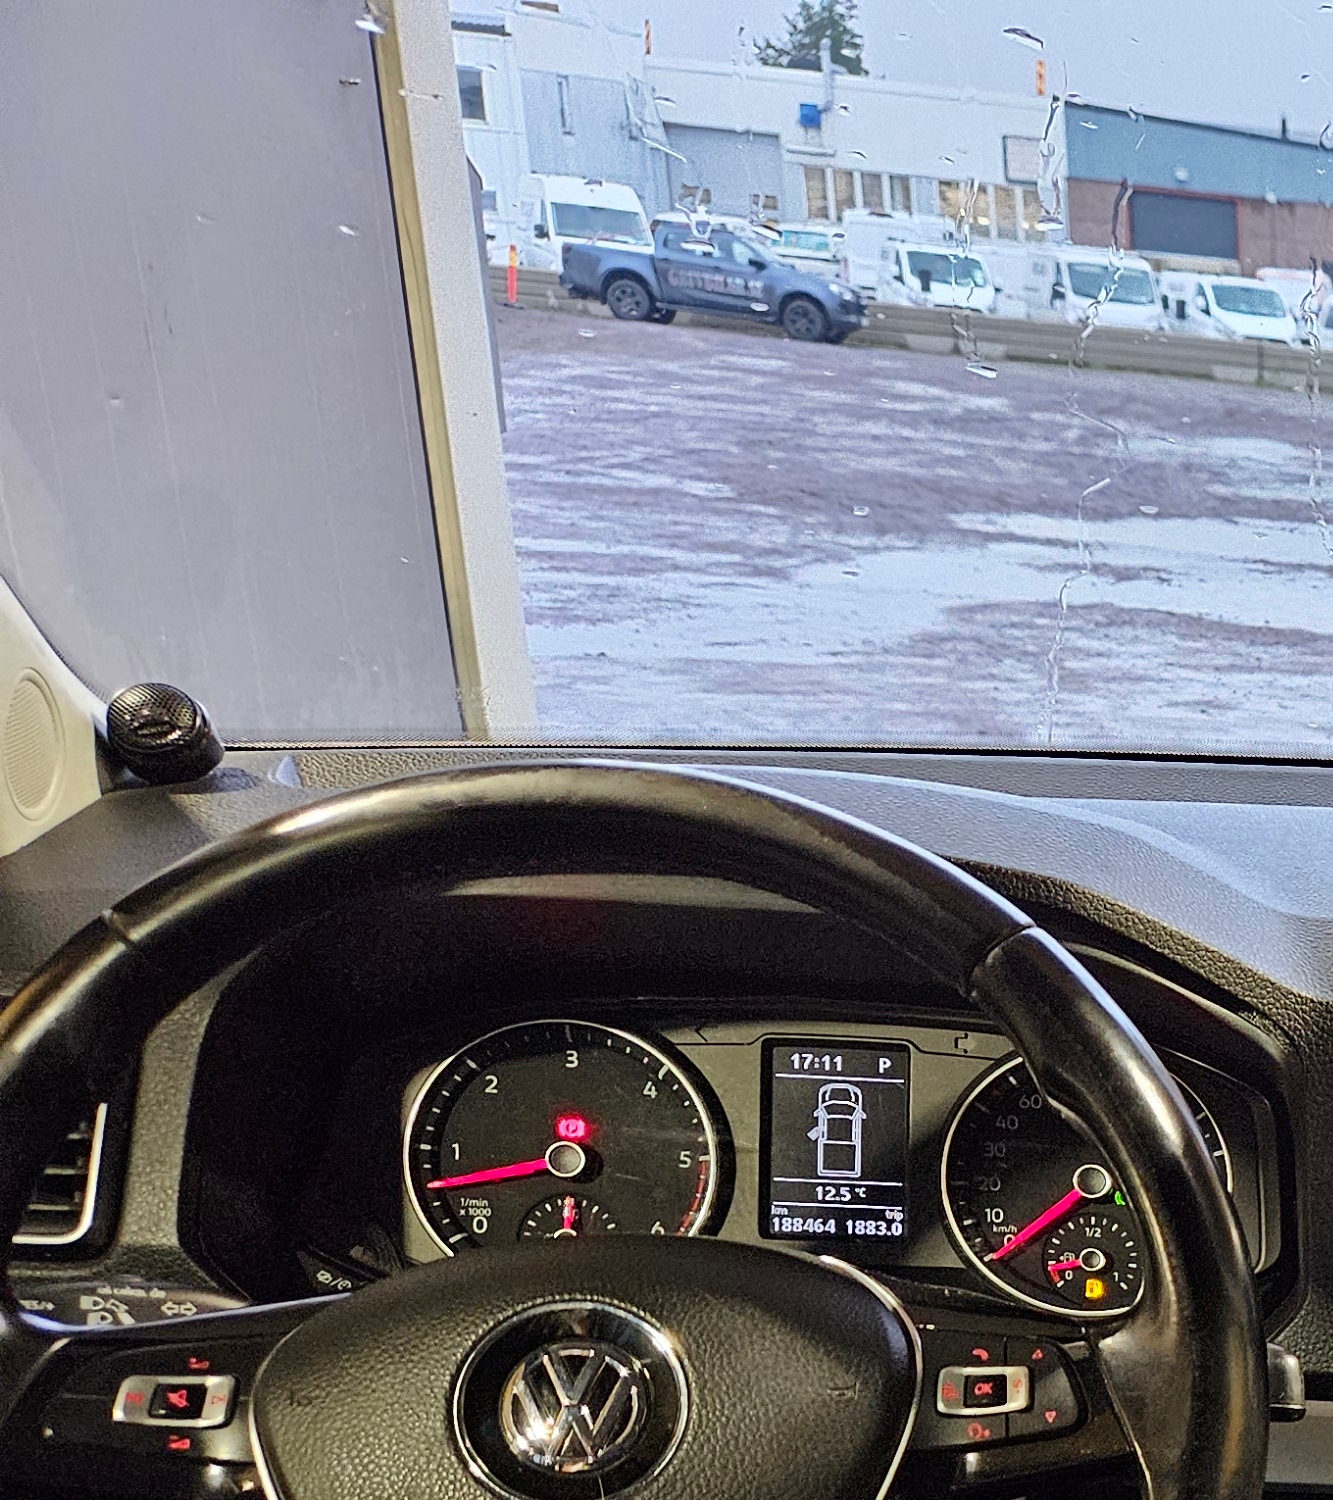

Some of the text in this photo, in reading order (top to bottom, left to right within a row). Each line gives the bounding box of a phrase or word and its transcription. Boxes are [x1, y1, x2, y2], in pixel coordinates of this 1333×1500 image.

[565, 1050, 579, 1069] 3
[790, 1053, 892, 1074] 17:11 P
[484, 1075, 499, 1094] 2
[642, 1081, 657, 1099] 4
[1018, 1093, 1042, 1109] 60
[995, 1115, 1019, 1130] 40
[451, 1143, 460, 1161] 1
[678, 1152, 692, 1169] 5
[815, 1185, 852, 1202] 12.5
[460, 1197, 489, 1208] 1/min
[770, 1204, 789, 1216] km
[468, 1206, 492, 1217] 1000
[984, 1207, 1004, 1224] 10
[472, 1216, 489, 1235] 0
[772, 1216, 903, 1236] 188464 1883.0
[992, 1223, 1018, 1234] km/h
[1084, 1226, 1102, 1238] 1/2
[974, 1382, 994, 1396] OK
